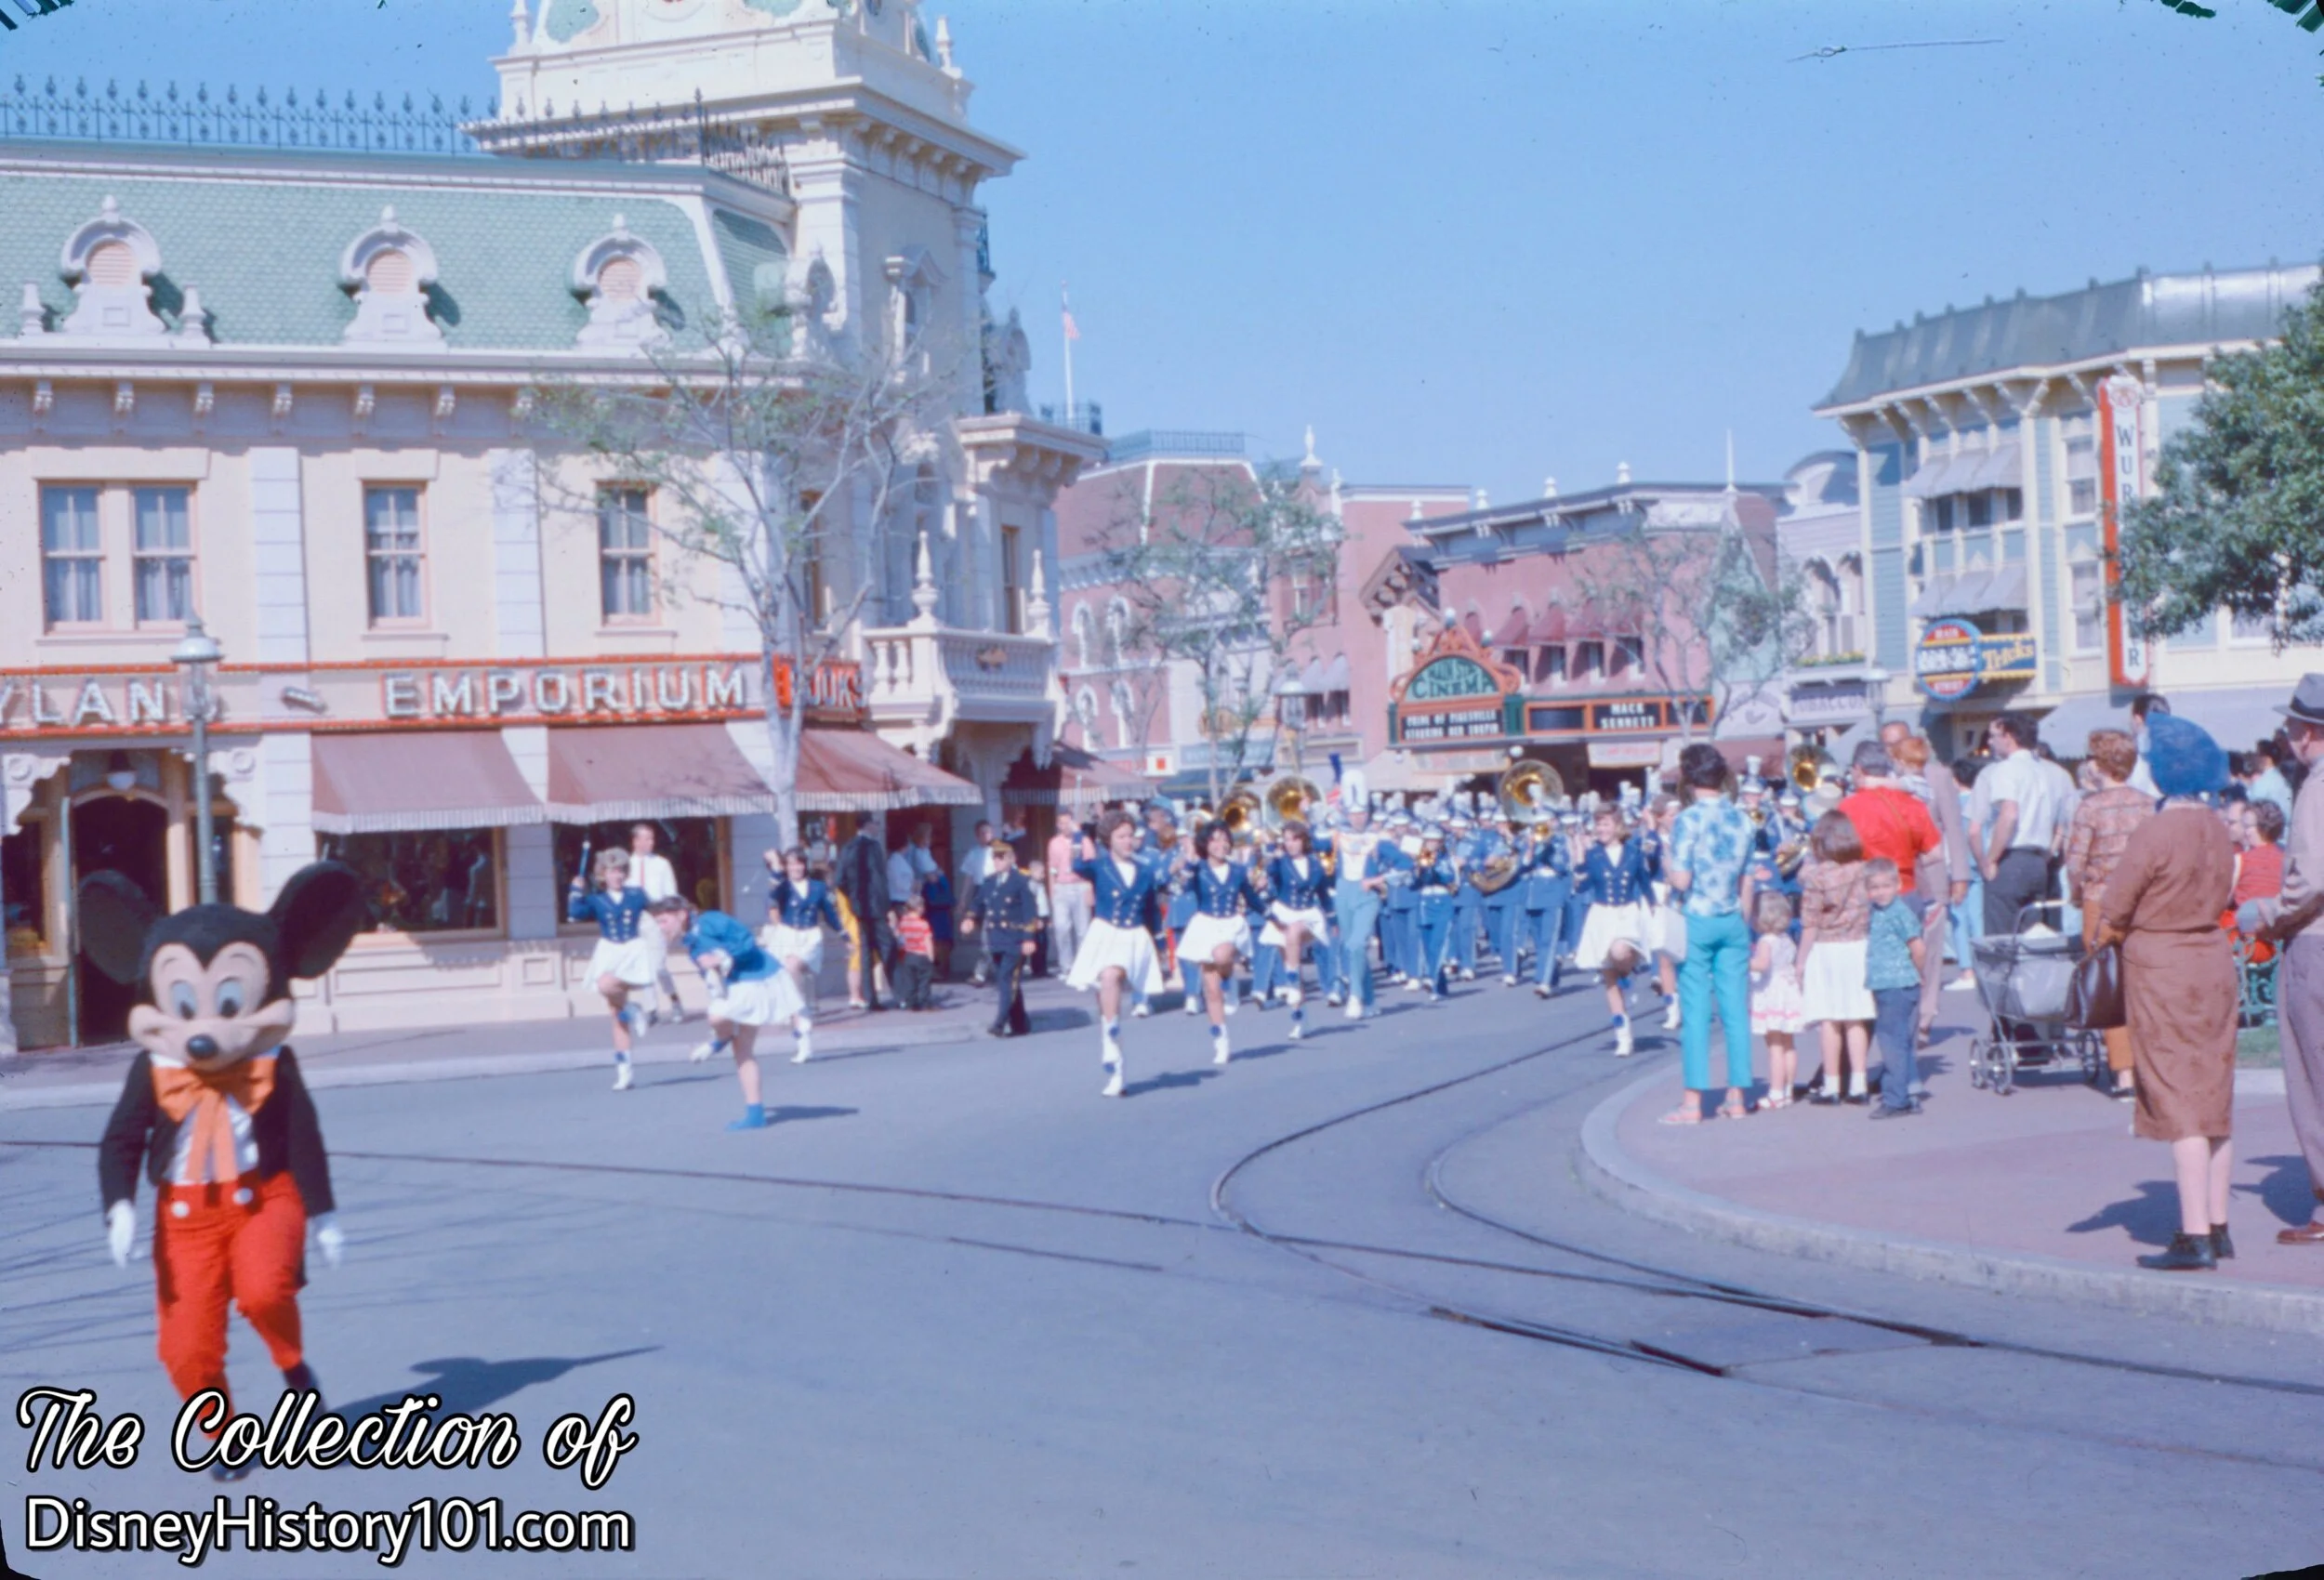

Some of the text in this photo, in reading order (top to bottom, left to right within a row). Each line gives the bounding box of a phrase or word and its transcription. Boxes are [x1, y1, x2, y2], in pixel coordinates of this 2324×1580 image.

[382, 664, 745, 718] EMPORIUM
[1412, 670, 1498, 700] CINEMA
[1611, 703, 1644, 716] MACK
[1601, 716, 1655, 730] SENNETT
